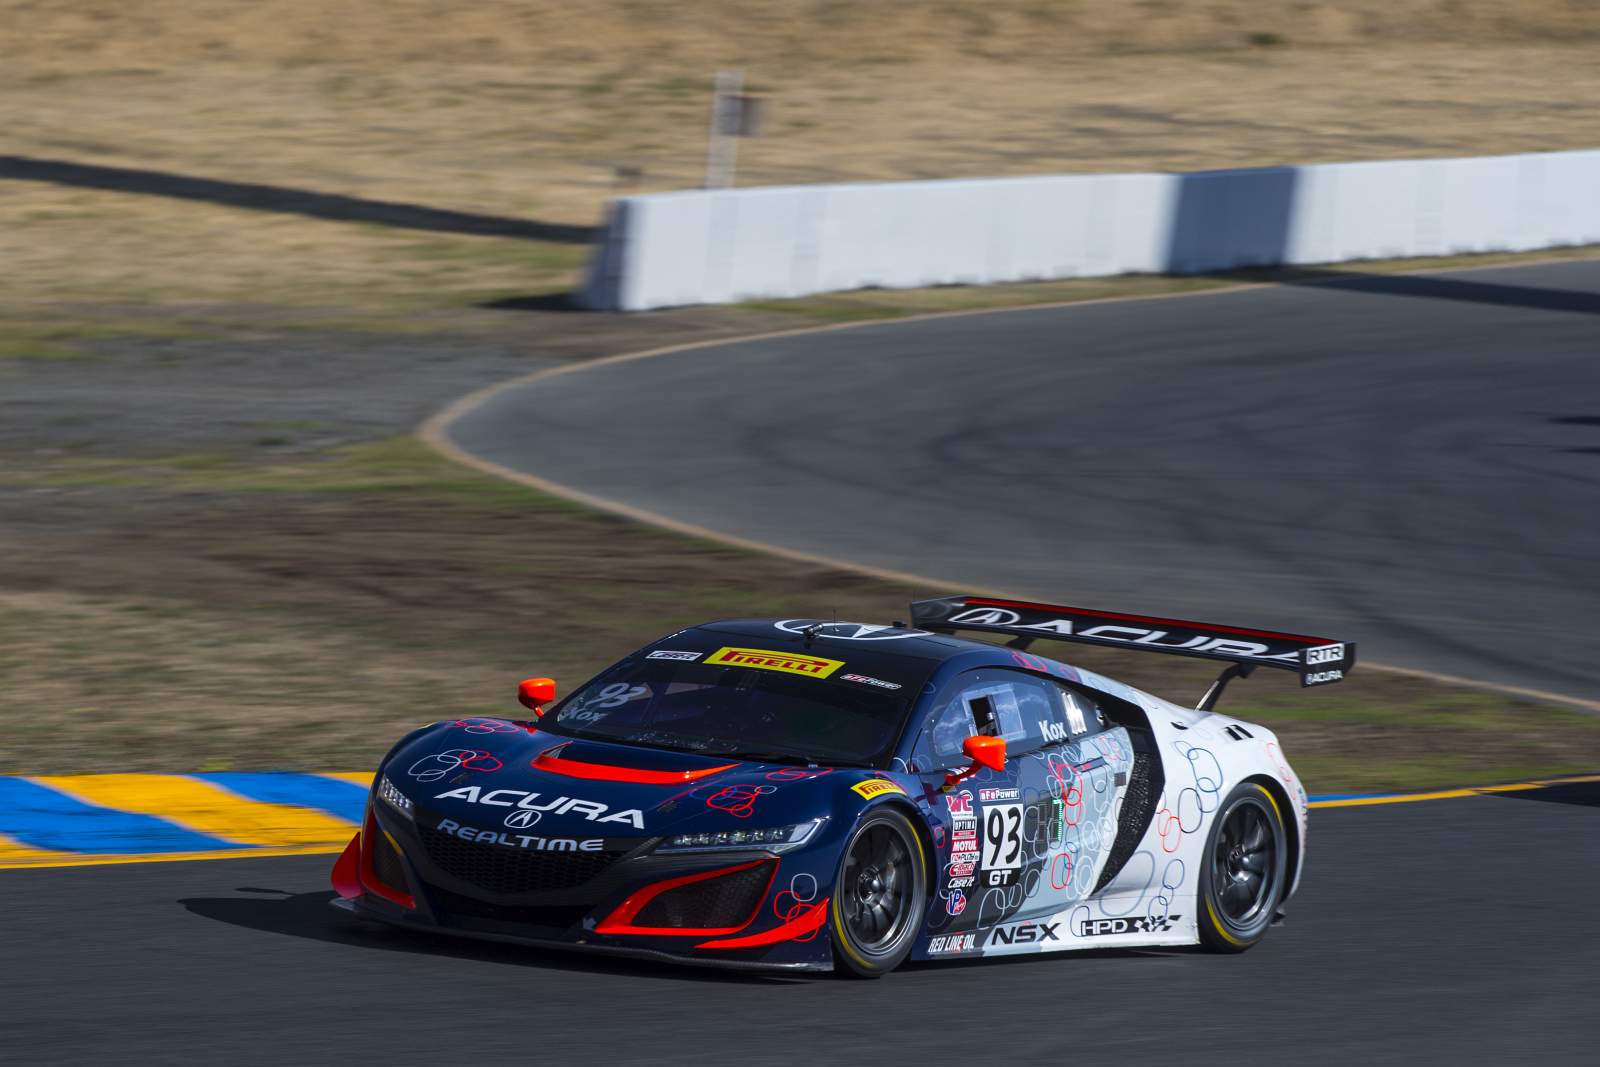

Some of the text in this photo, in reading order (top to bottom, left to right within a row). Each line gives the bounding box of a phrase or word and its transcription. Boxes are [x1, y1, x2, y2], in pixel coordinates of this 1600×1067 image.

[1011, 619, 1300, 663] ACURA
[720, 651, 829, 674] PIRELLI
[1308, 646, 1341, 662] RTR
[1311, 670, 1344, 683] ACURA
[1038, 719, 1068, 743] Kox
[434, 786, 645, 830] ACURA
[437, 818, 605, 852] REALTIME
[954, 819, 976, 831] OPTIMA
[952, 840, 977, 852] MOTUL
[987, 806, 1021, 867] 93
[989, 869, 1012, 886] GT
[991, 922, 1061, 946] NSX
[1081, 919, 1129, 936] HPD
[927, 933, 976, 953] RED LINE OIL
